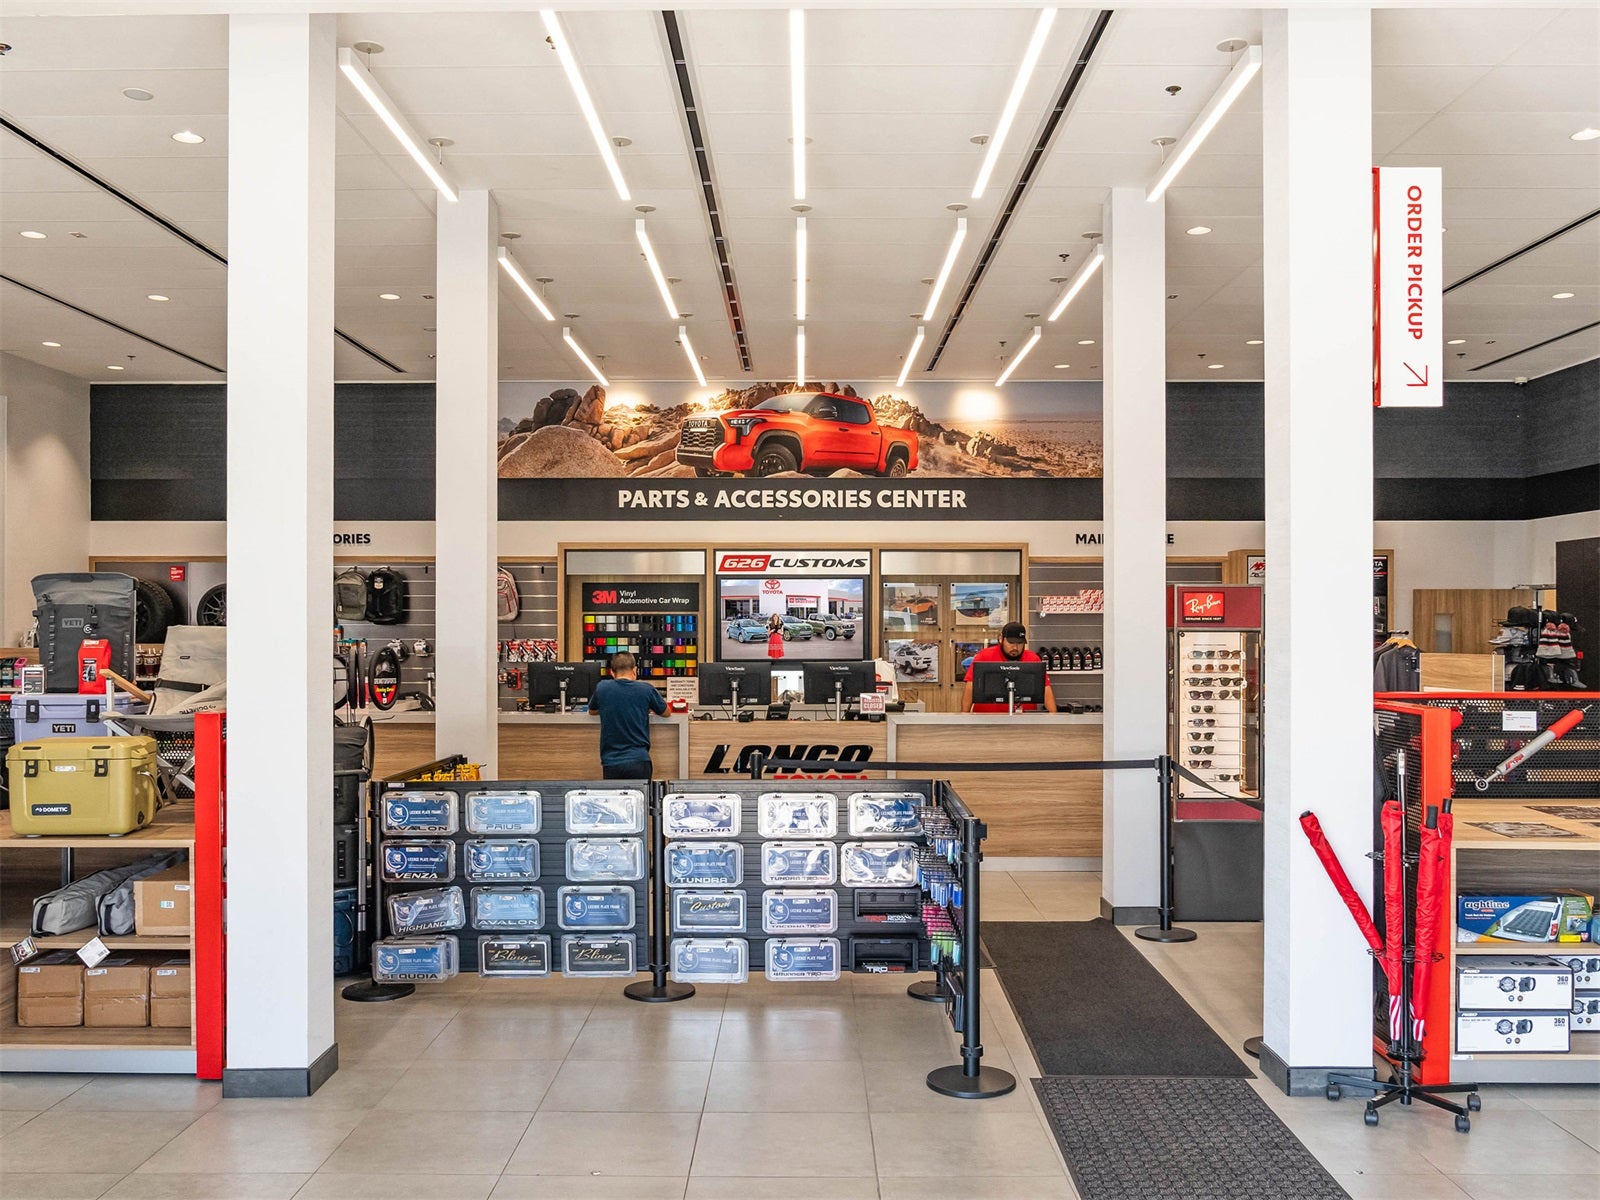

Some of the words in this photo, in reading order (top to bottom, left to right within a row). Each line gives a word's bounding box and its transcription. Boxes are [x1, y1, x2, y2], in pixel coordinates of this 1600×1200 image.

[1407, 185, 1422, 258] ORDER
[1407, 264, 1422, 340] PICKUP
[688, 420, 708, 428] TOYOTA
[617, 489, 690, 509] PARTS
[694, 491, 709, 509] &
[713, 489, 873, 509] ACCESSORIES
[876, 489, 967, 509] CENTER
[723, 558, 765, 568] 626
[768, 558, 868, 568] CUSTOMS
[591, 590, 617, 604] 3M
[619, 590, 637, 598] Vinyl
[671, 597, 690, 605] Wrap
[1185, 594, 1221, 614] Ray-Ban
[63, 619, 83, 627] YETI
[53, 724, 76, 732] YETI
[703, 744, 874, 774] LONGO
[1464, 899, 1510, 911] rightline
[397, 919, 459, 934] HIGHLANDER
[491, 949, 536, 962] Bling
[575, 948, 621, 962] Bling
